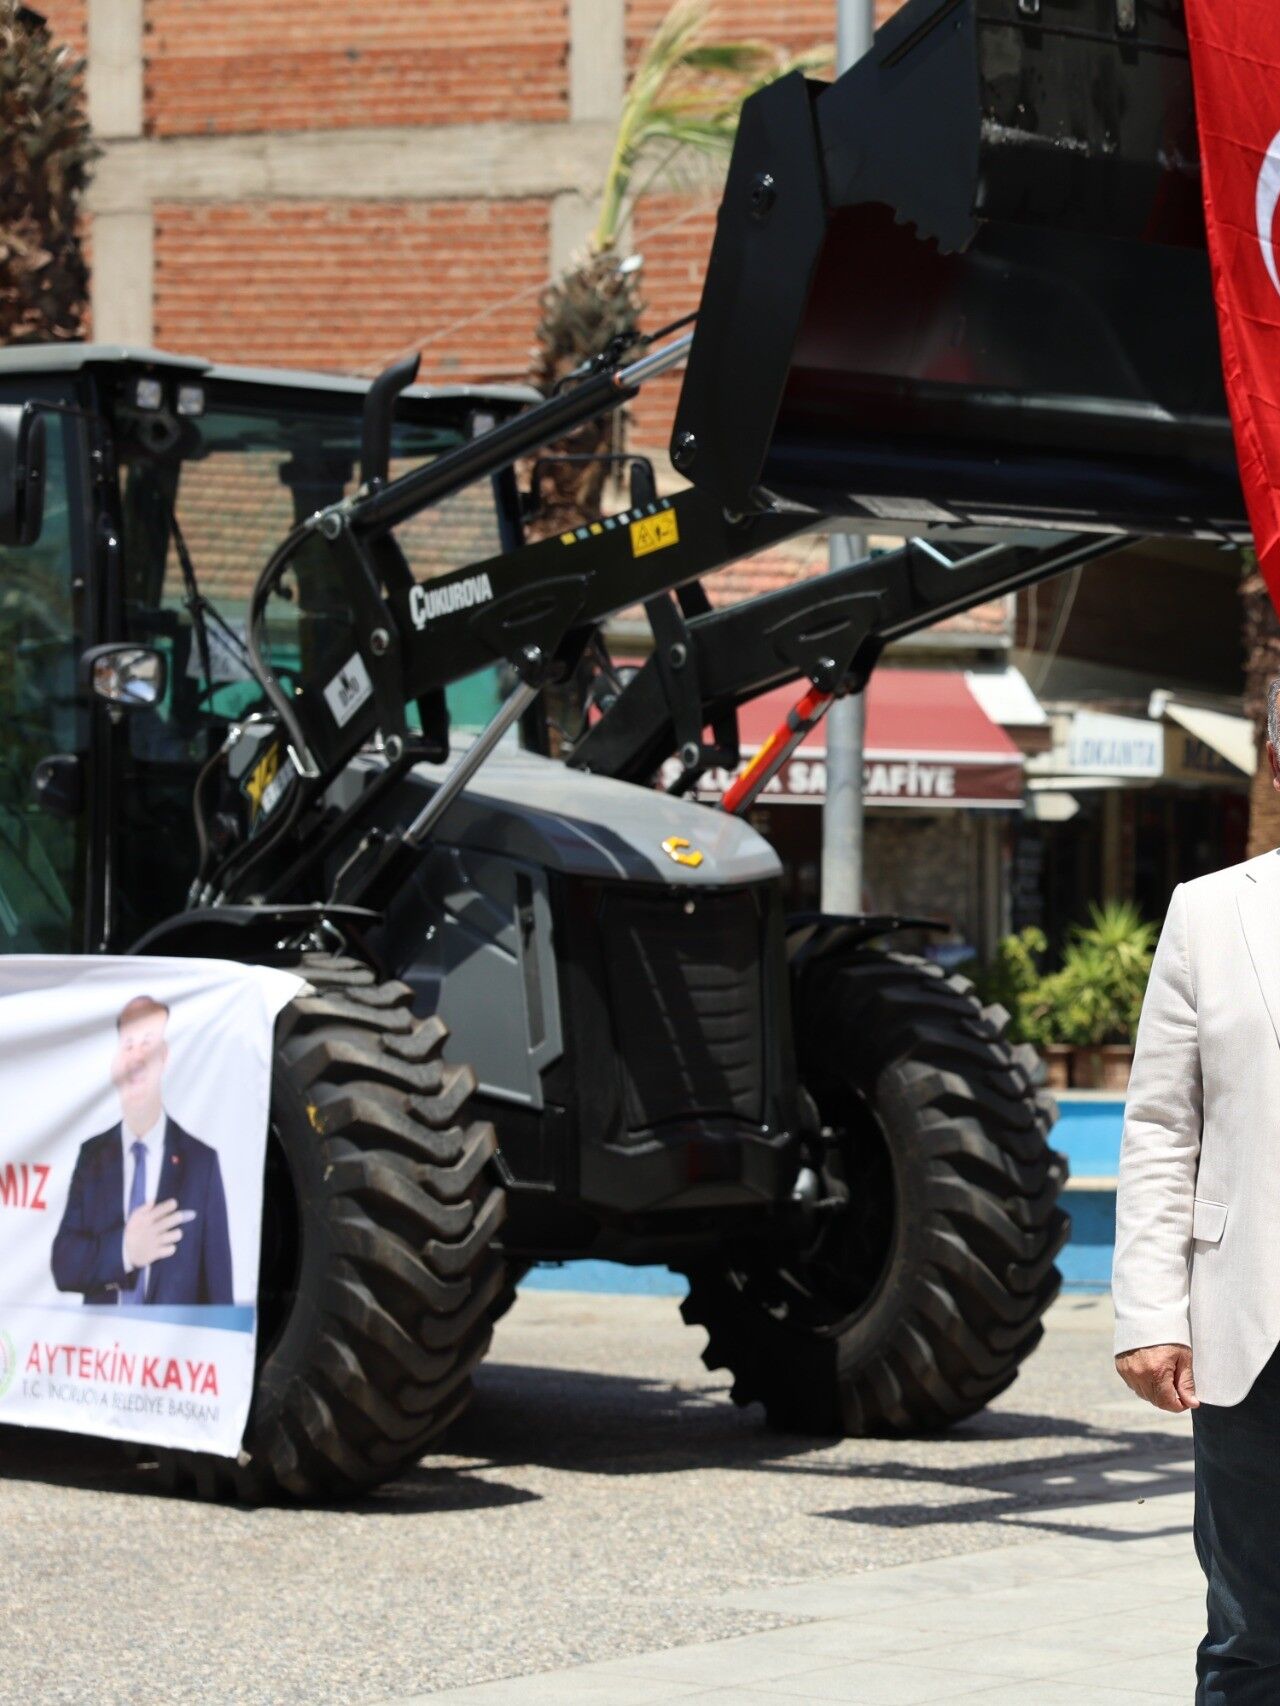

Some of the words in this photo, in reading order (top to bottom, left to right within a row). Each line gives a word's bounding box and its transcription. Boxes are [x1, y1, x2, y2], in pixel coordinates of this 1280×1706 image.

[409, 572, 494, 631] ÇUKUROVA
[26, 1341, 136, 1385] AYTEKİN
[141, 1355, 220, 1397] KAYA
